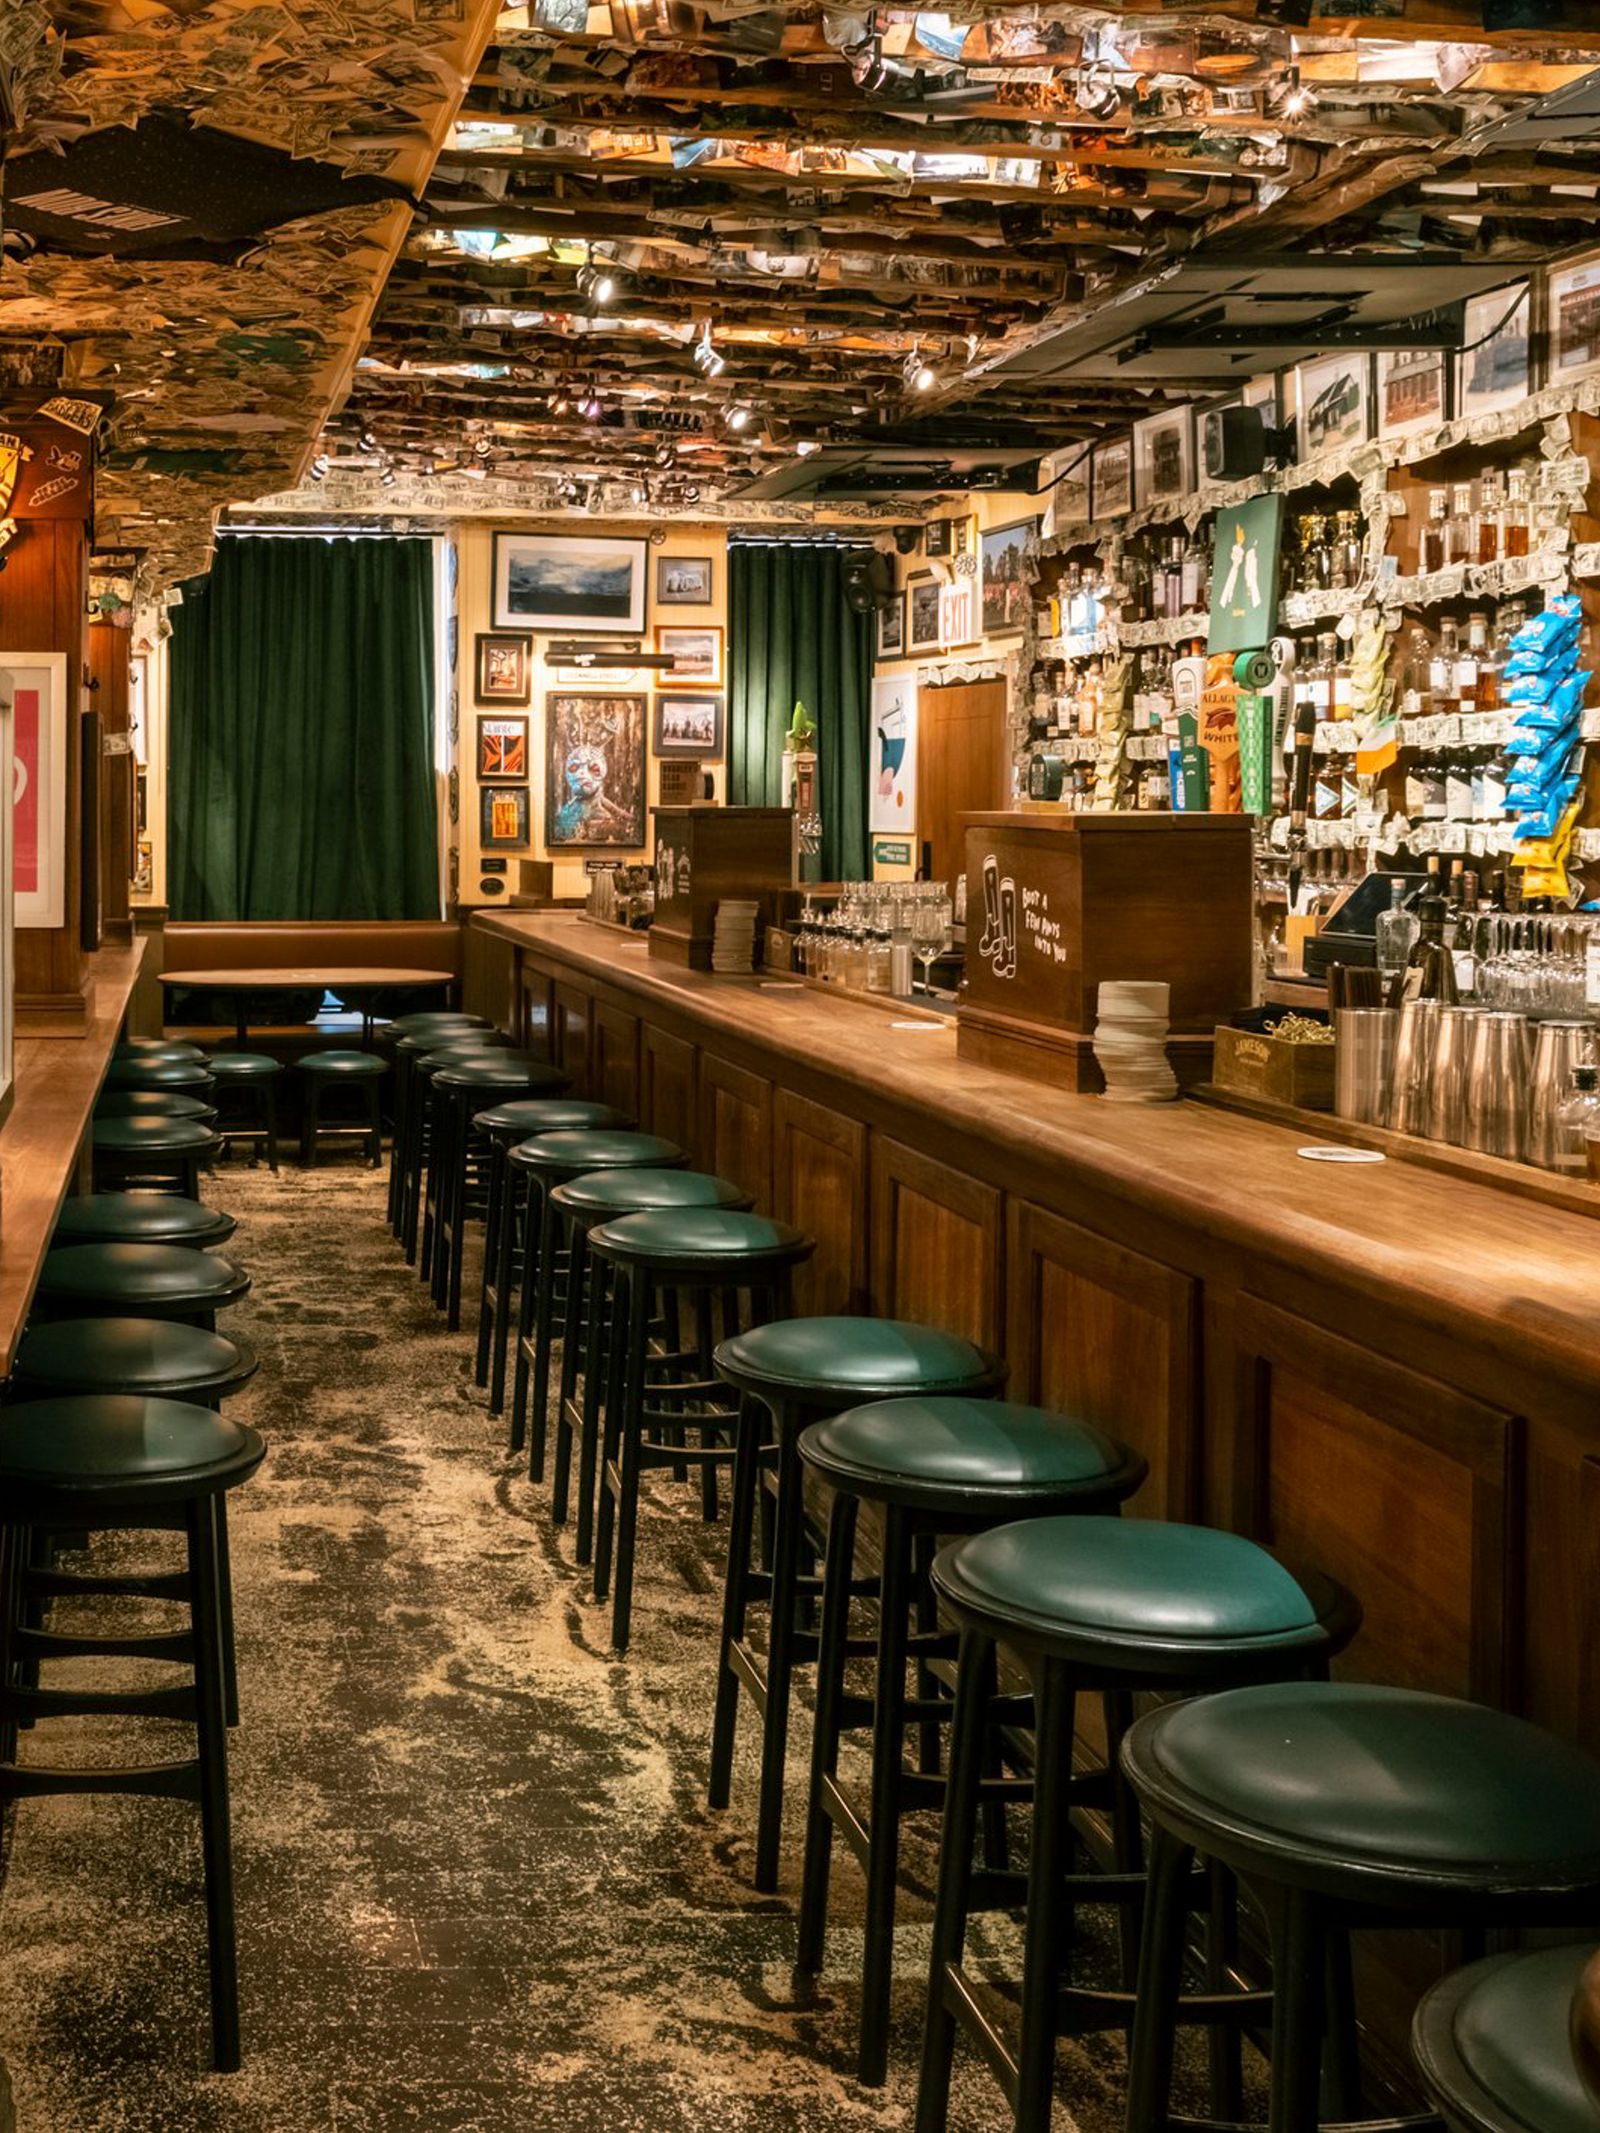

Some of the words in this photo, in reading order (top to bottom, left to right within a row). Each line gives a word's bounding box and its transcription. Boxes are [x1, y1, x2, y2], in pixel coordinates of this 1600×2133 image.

[944, 592, 968, 642] EXIT
[1202, 692, 1236, 704] ALLAGA
[1025, 909, 1041, 931] FEW
[1041, 916, 1060, 939] PINTS
[1034, 934, 1052, 955] INTO
[1052, 942, 1067, 963] YOU
[1234, 1039, 1271, 1064] JAMESON
